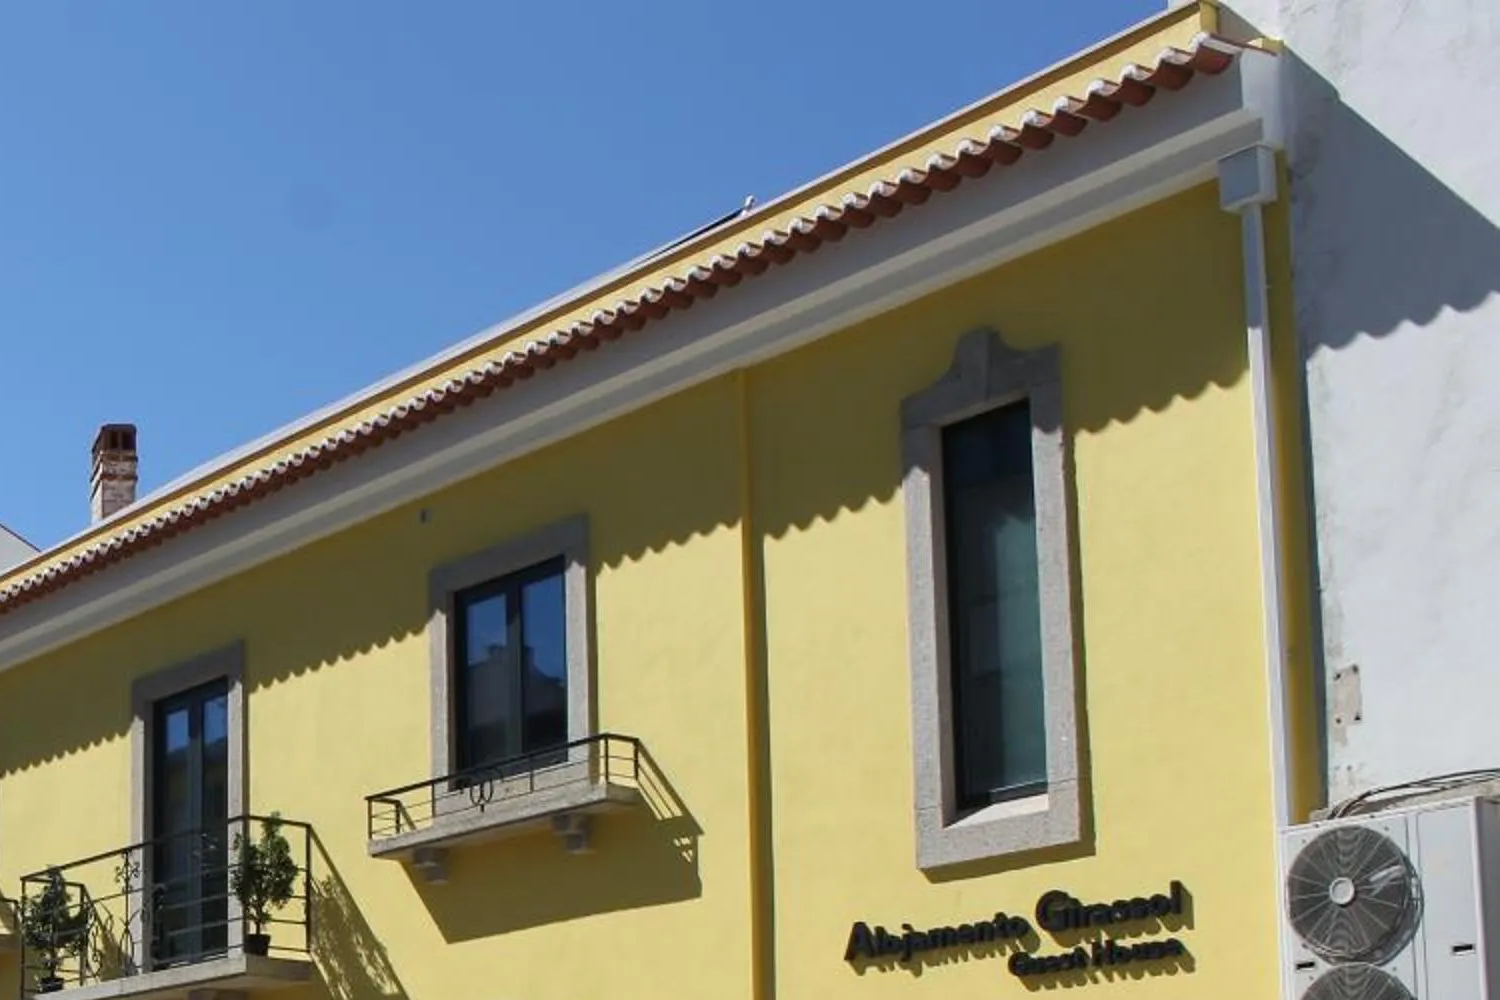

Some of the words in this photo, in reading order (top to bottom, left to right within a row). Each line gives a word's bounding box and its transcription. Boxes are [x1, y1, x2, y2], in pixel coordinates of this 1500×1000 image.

[844, 912, 1030, 960] Alojamento
[1008, 947, 1088, 976] Guest
[1091, 938, 1186, 967] House
